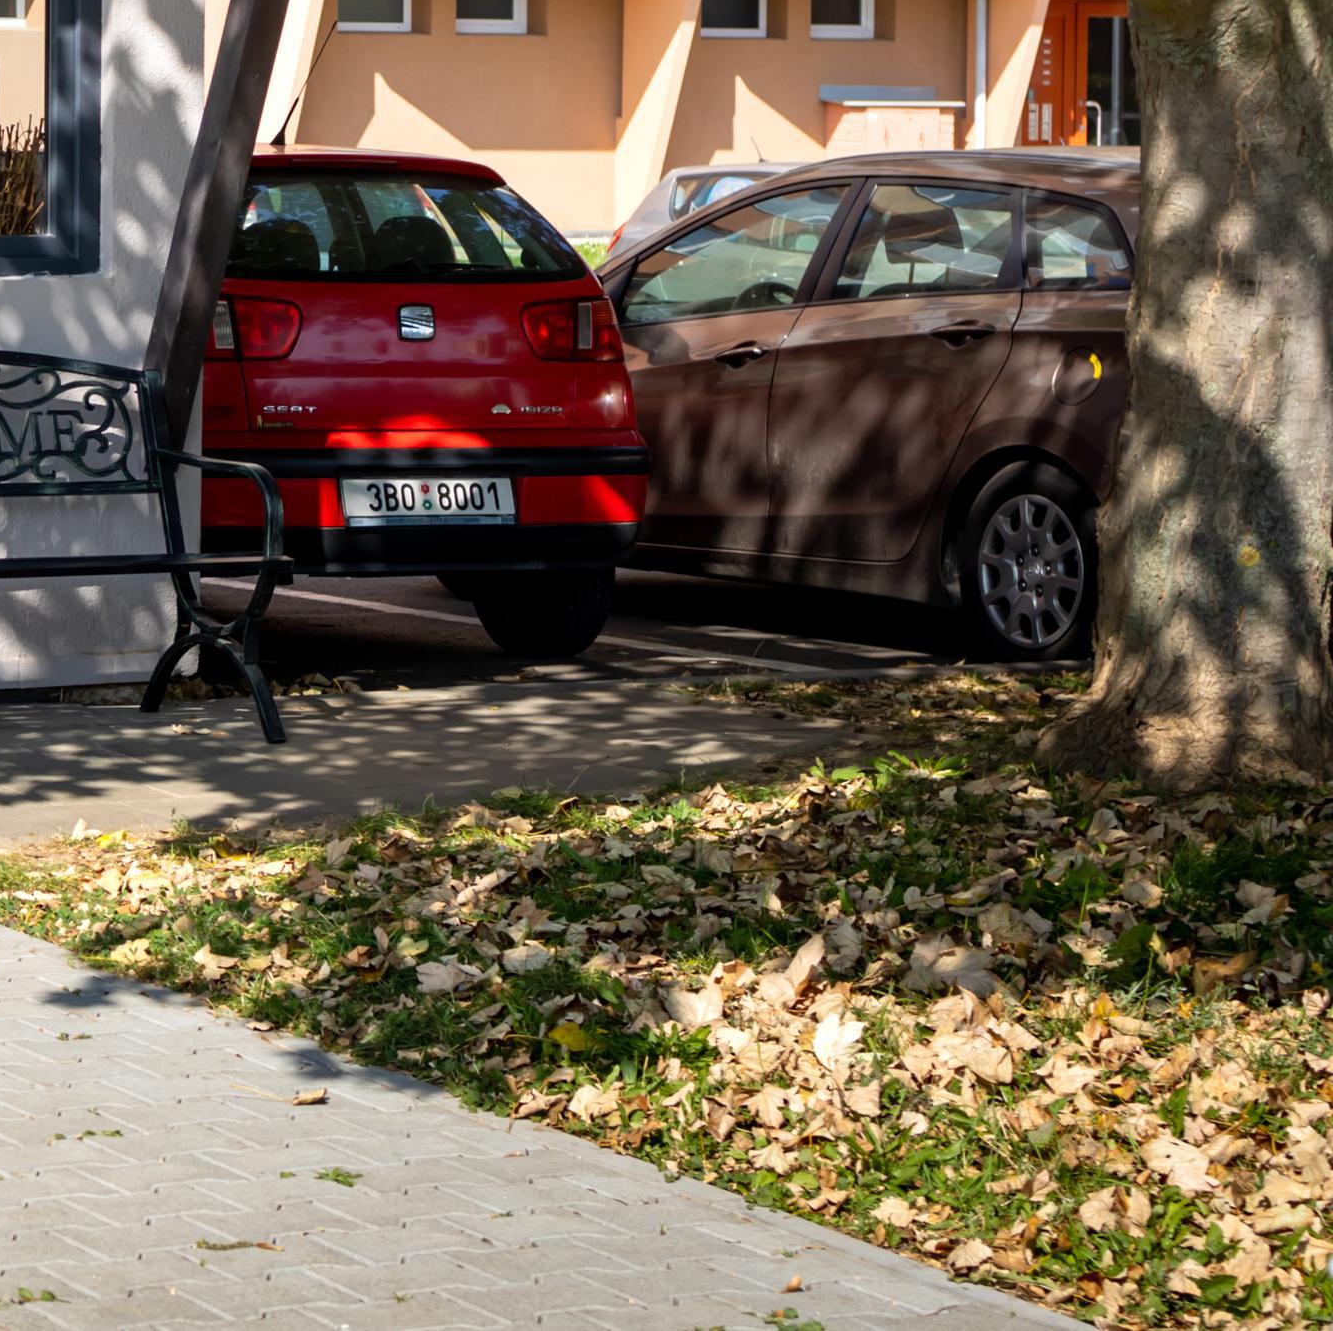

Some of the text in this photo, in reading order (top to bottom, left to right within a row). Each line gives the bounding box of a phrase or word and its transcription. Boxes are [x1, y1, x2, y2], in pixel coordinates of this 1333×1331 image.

[263, 405, 318, 414] SEAT
[366, 481, 501, 512] 3B0 8001
